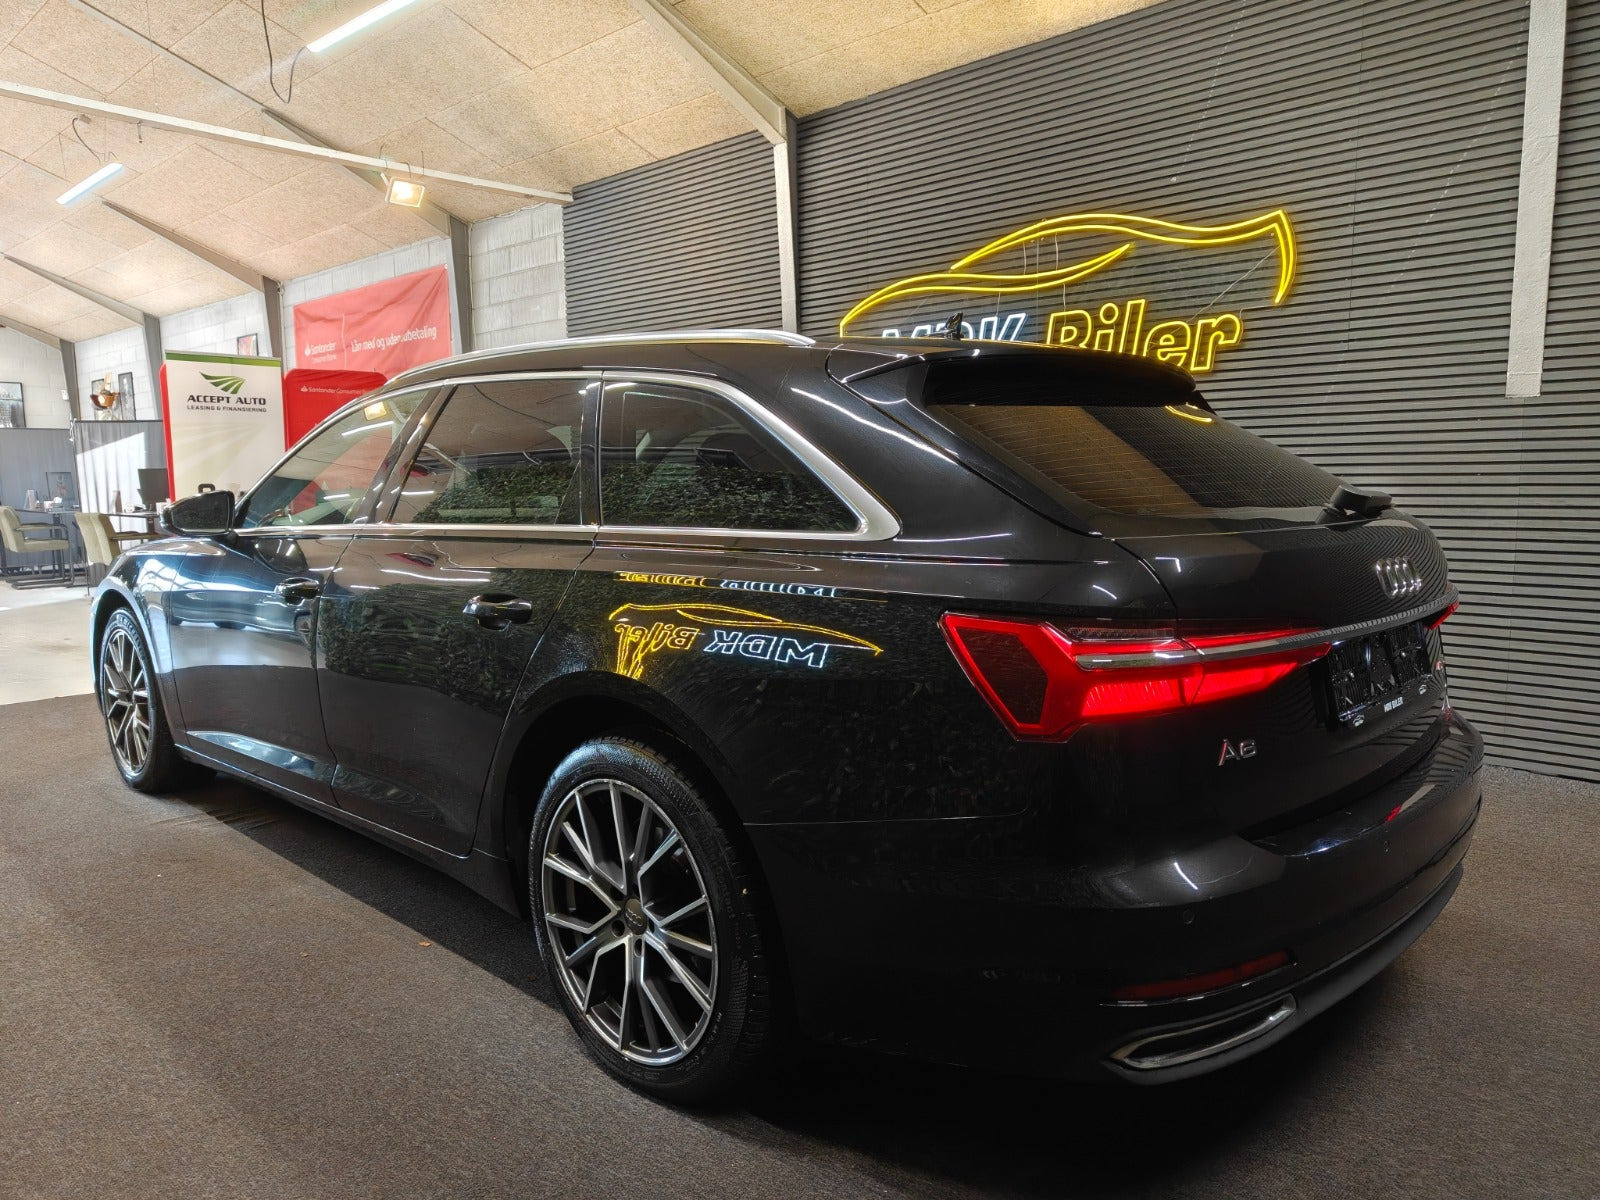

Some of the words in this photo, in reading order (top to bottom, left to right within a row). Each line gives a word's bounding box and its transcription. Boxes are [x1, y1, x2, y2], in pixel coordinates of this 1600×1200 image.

[311, 341, 337, 355] Santander
[351, 339, 362, 353] Lån
[362, 336, 376, 350] med
[376, 337, 385, 351] og
[308, 386, 336, 394] Santander
[187, 394, 231, 404] ACCEPT
[235, 396, 267, 406] AUTO
[1218, 738, 1257, 767] A6
